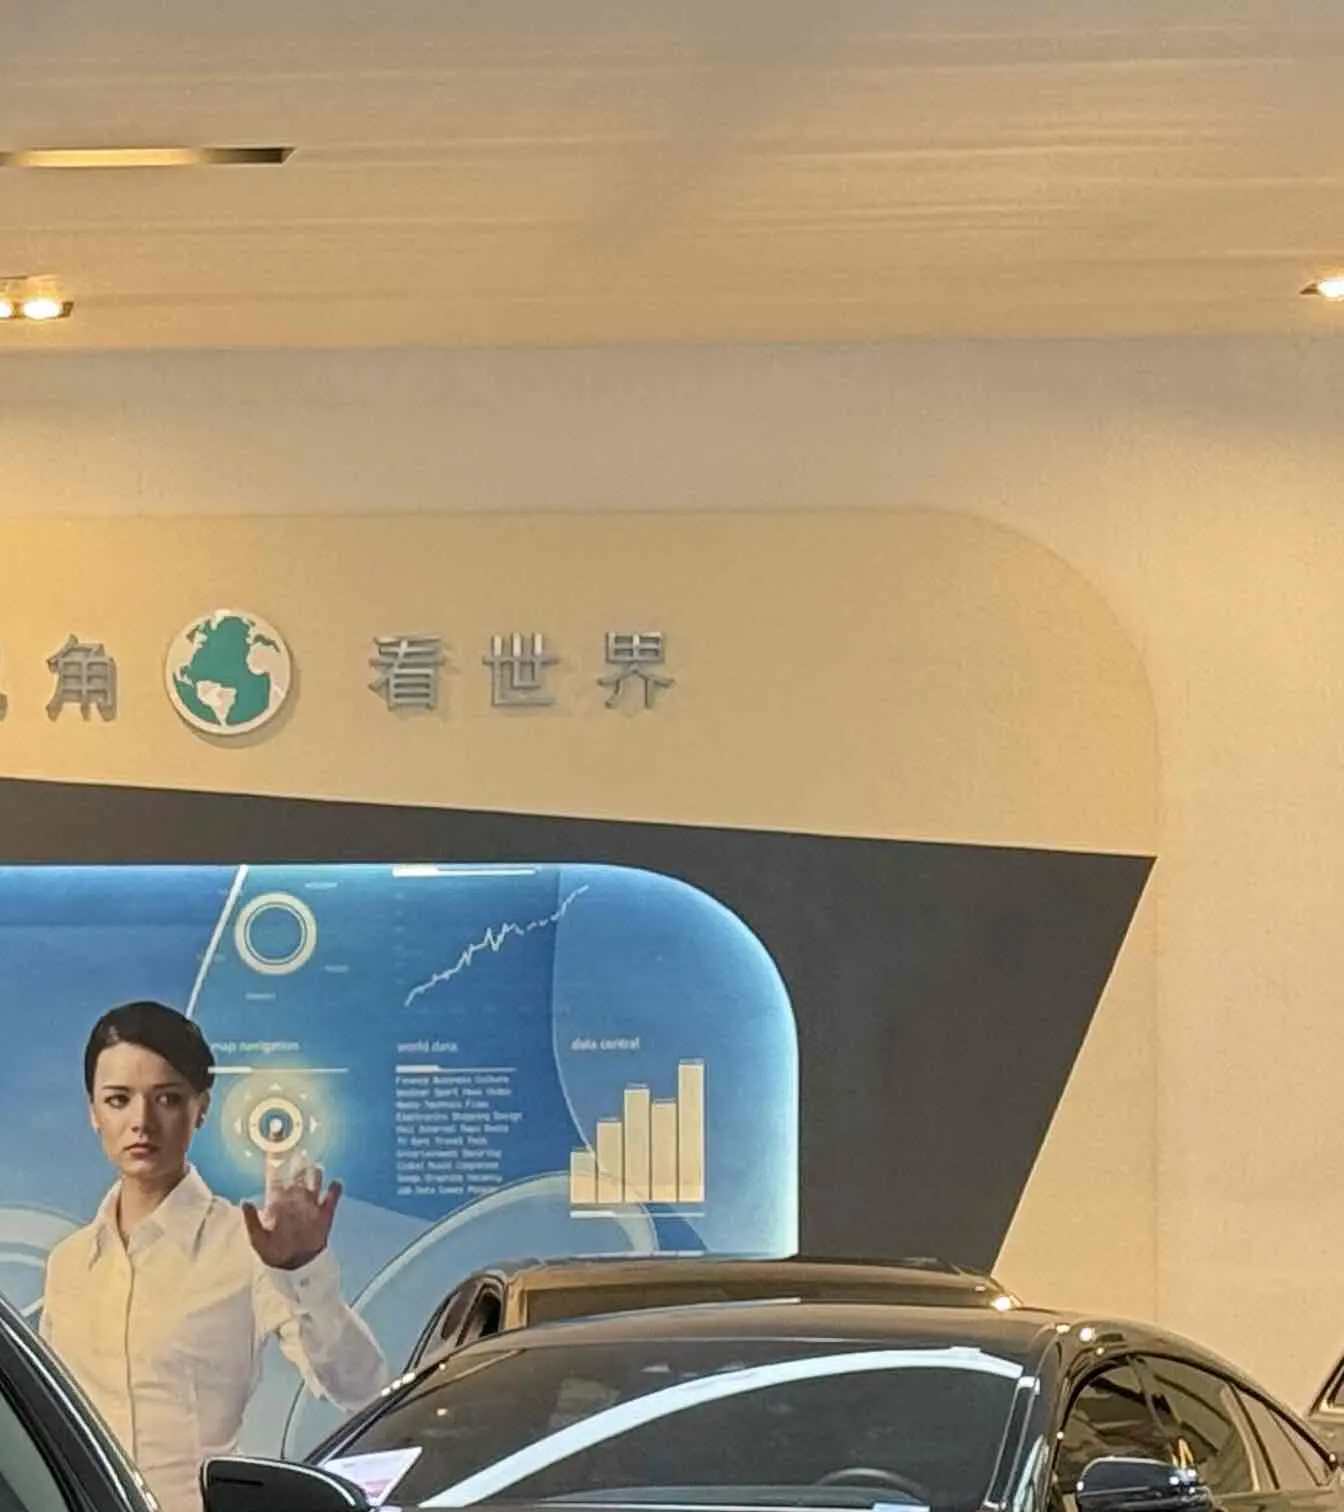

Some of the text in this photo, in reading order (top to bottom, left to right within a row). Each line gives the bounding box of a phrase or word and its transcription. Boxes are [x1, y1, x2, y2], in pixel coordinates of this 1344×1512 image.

[367, 631, 675, 712] 看世界
[431, 1038, 459, 1052] data
[570, 1036, 598, 1051] data
